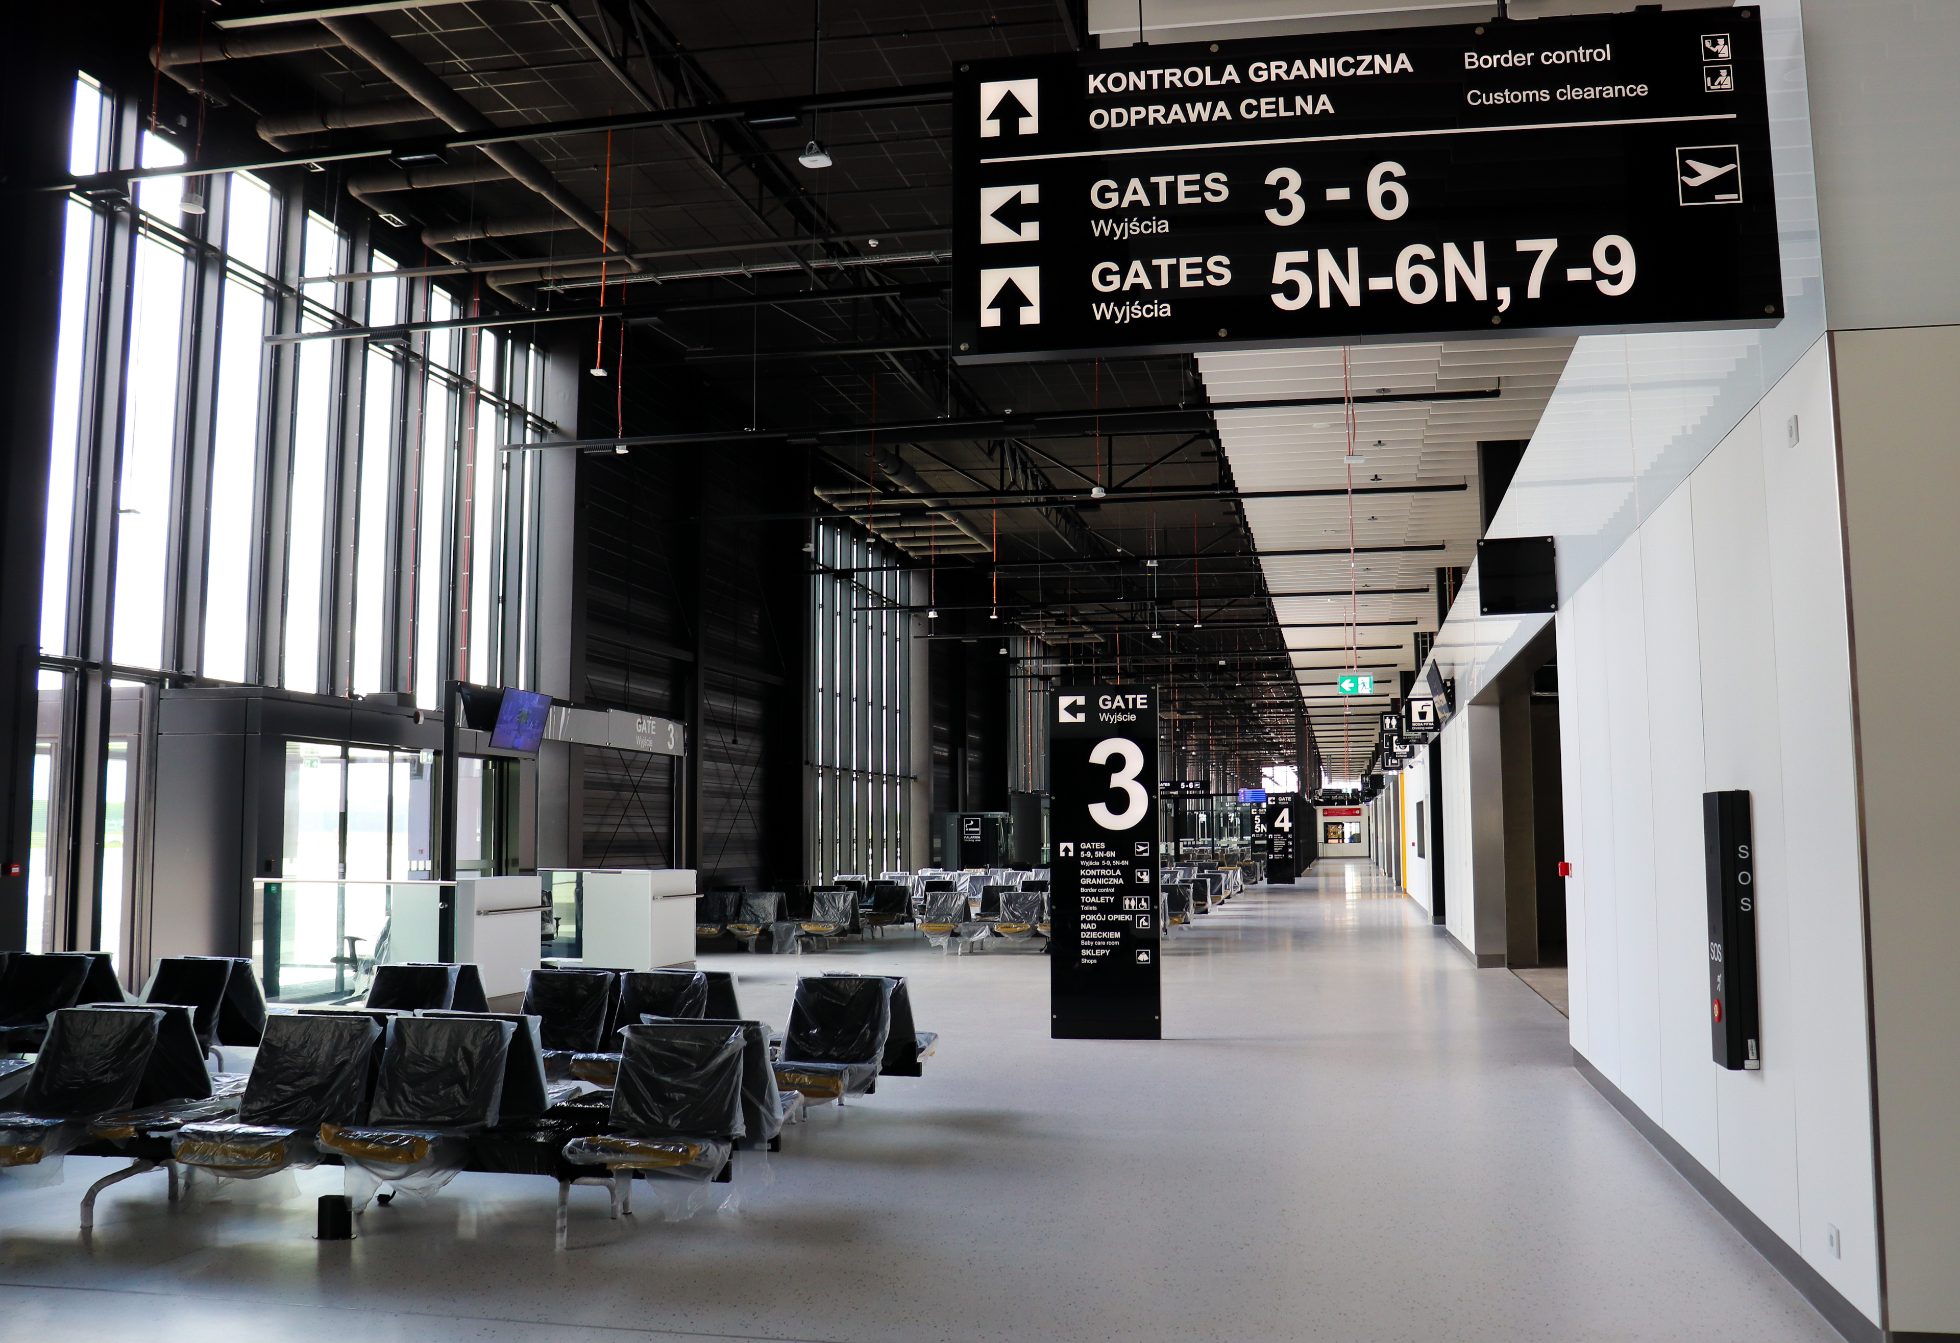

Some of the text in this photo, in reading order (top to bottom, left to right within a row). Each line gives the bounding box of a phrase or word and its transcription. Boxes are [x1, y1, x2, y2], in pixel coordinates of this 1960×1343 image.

[1463, 43, 1612, 71] Border control
[1087, 52, 1415, 95] KONTROLA GRANICZNA
[1466, 81, 1650, 107] Customs clearance
[1088, 93, 1335, 131] ODPRAWA CELNA
[1090, 172, 1230, 211] GATES
[1264, 167, 1306, 227] 3
[1366, 160, 1409, 221] 6
[1090, 215, 1171, 240] Wyjścia
[1091, 254, 1232, 293] GATES
[1091, 299, 1173, 324] Wyjścia
[1098, 694, 1148, 710] GATE
[636, 718, 656, 735] GATE
[1099, 712, 1137, 724] Wyjście
[667, 723, 675, 750] 3
[1087, 737, 1149, 831] 3
[1254, 815, 1261, 824] 5
[1274, 807, 1293, 833] 4
[1080, 877, 1124, 885] GRANICZNA
[1080, 912, 1106, 921] POKÓJ
[1080, 922, 1097, 930] NAD
[1080, 931, 1121, 939] DZIECKIEM
[1710, 942, 1722, 963] SOS
